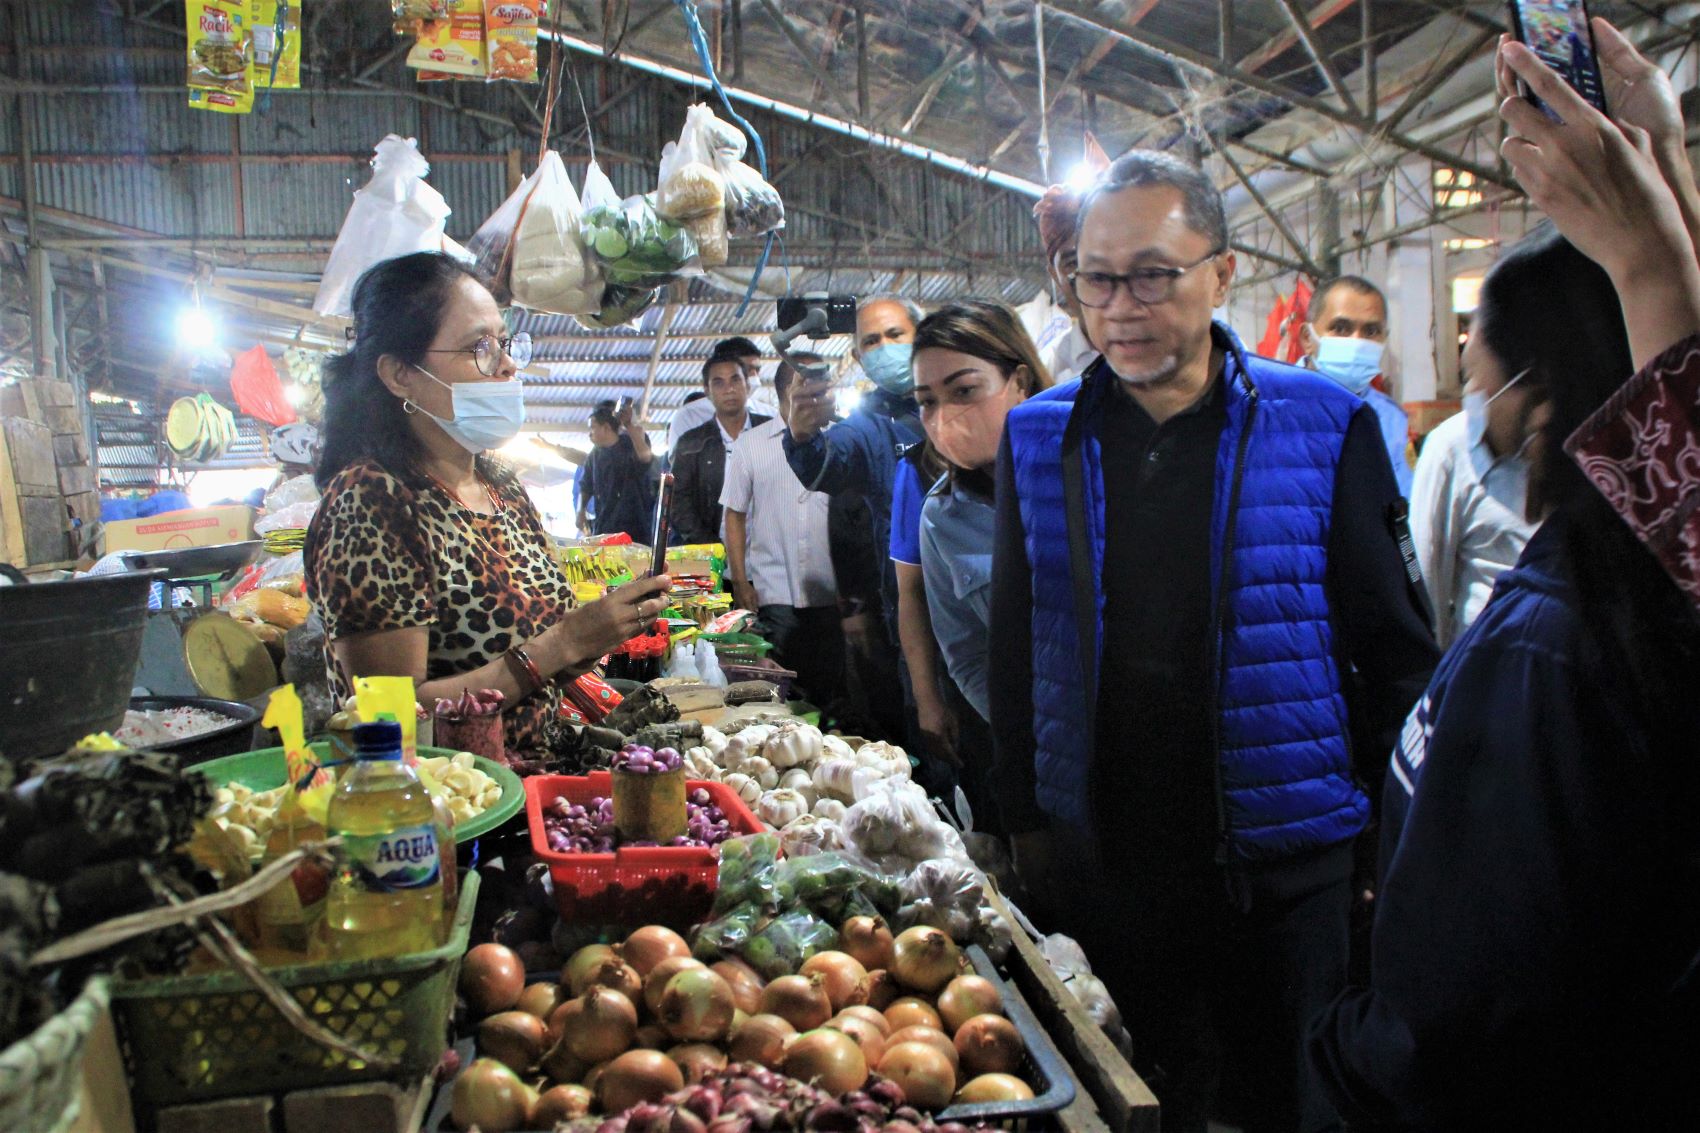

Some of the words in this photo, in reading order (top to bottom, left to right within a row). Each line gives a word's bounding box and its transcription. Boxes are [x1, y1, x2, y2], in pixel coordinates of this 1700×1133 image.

[199, 15, 234, 33] Racik
[496, 7, 533, 24] Sajiku
[376, 834, 435, 863] AQUA
